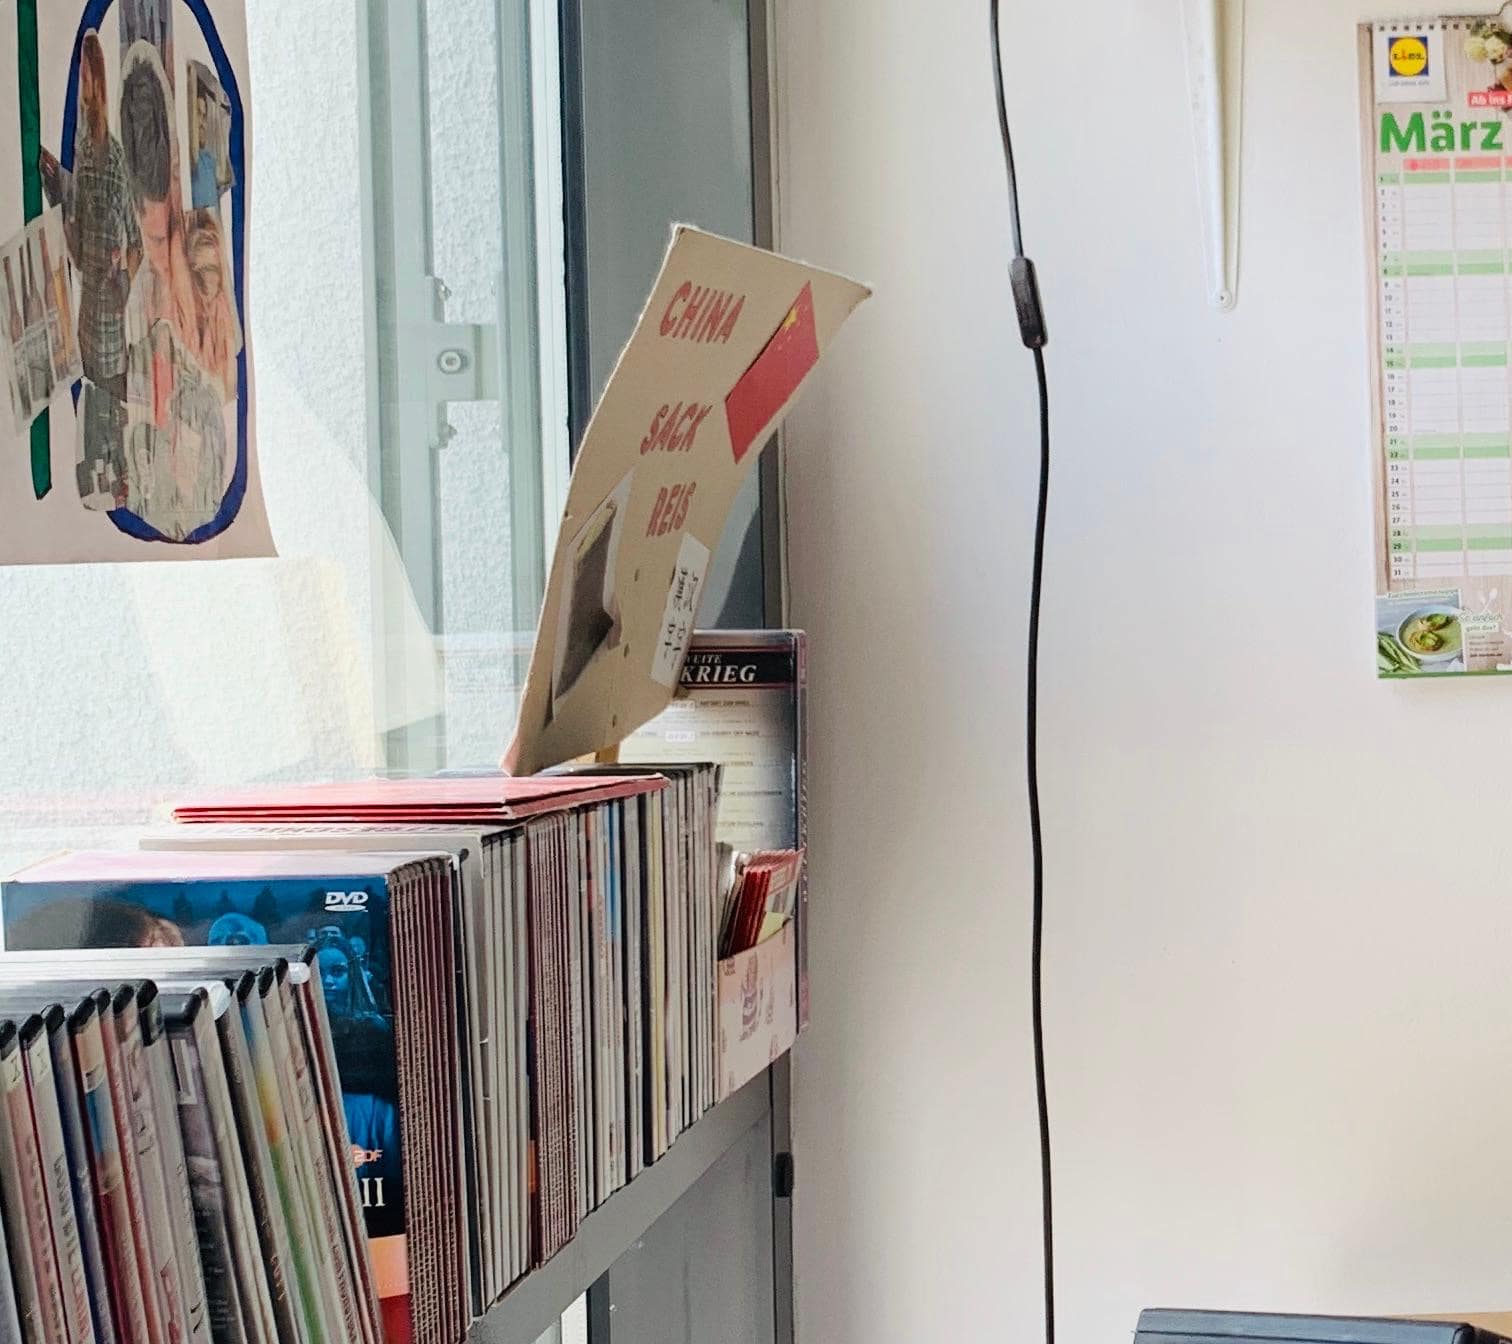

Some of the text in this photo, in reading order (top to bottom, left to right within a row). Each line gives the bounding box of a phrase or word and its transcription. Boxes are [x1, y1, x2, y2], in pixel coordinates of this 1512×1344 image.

[1379, 110, 1504, 153] März
[660, 280, 746, 344] CHINA
[640, 401, 713, 455] SACK
[646, 481, 697, 537] REIS
[680, 664, 758, 683] KRIEG
[324, 890, 369, 905] DVD
